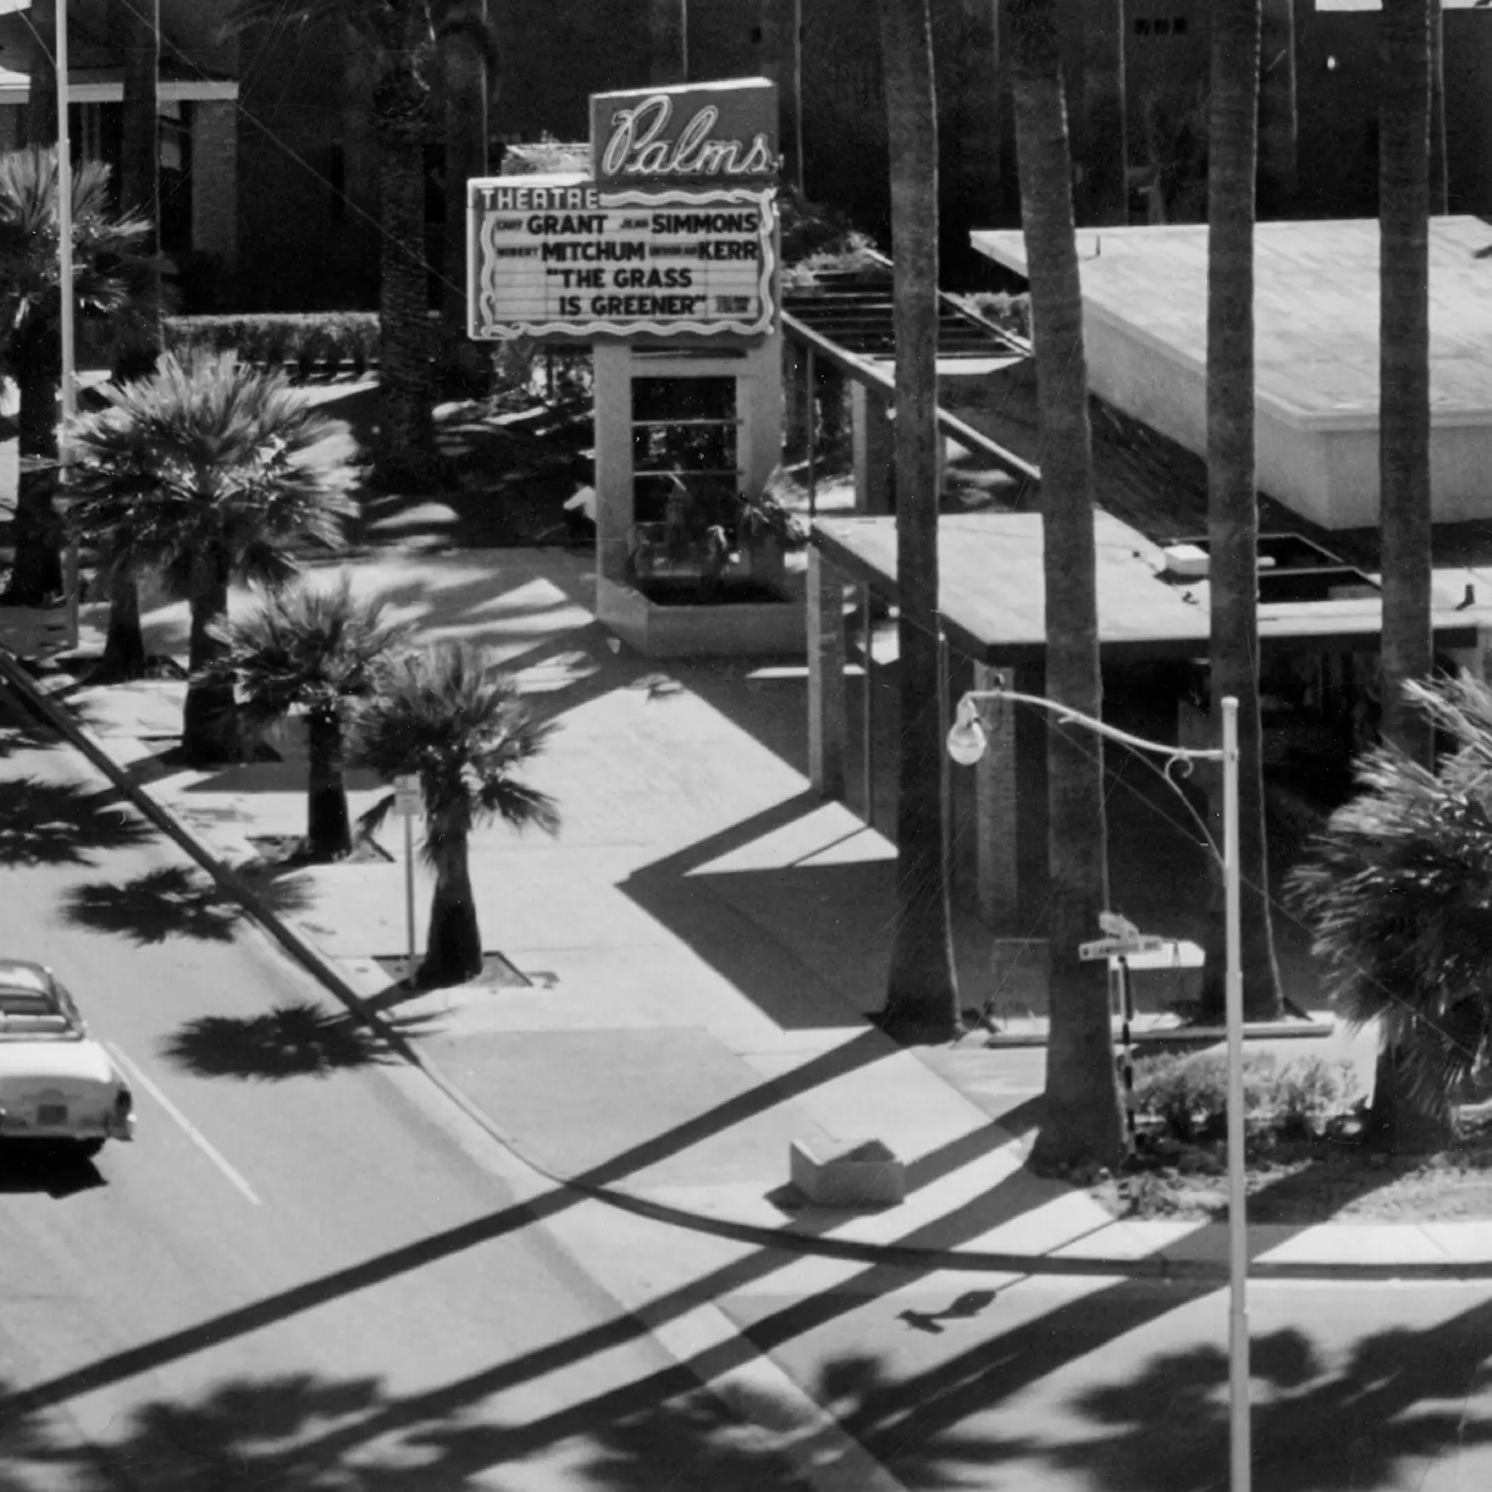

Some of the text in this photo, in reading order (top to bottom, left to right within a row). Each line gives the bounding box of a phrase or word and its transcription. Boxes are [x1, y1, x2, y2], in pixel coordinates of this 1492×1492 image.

[602, 93, 773, 176] Palms
[481, 188, 599, 210] THEATRE
[527, 213, 609, 235] GRANT
[651, 213, 759, 234] SIMMONS
[541, 241, 646, 262] MITCHUM
[698, 240, 759, 261] KERR
[613, 268, 693, 288] GRASS
[559, 295, 582, 316] IS
[590, 294, 707, 316] GREENER"
